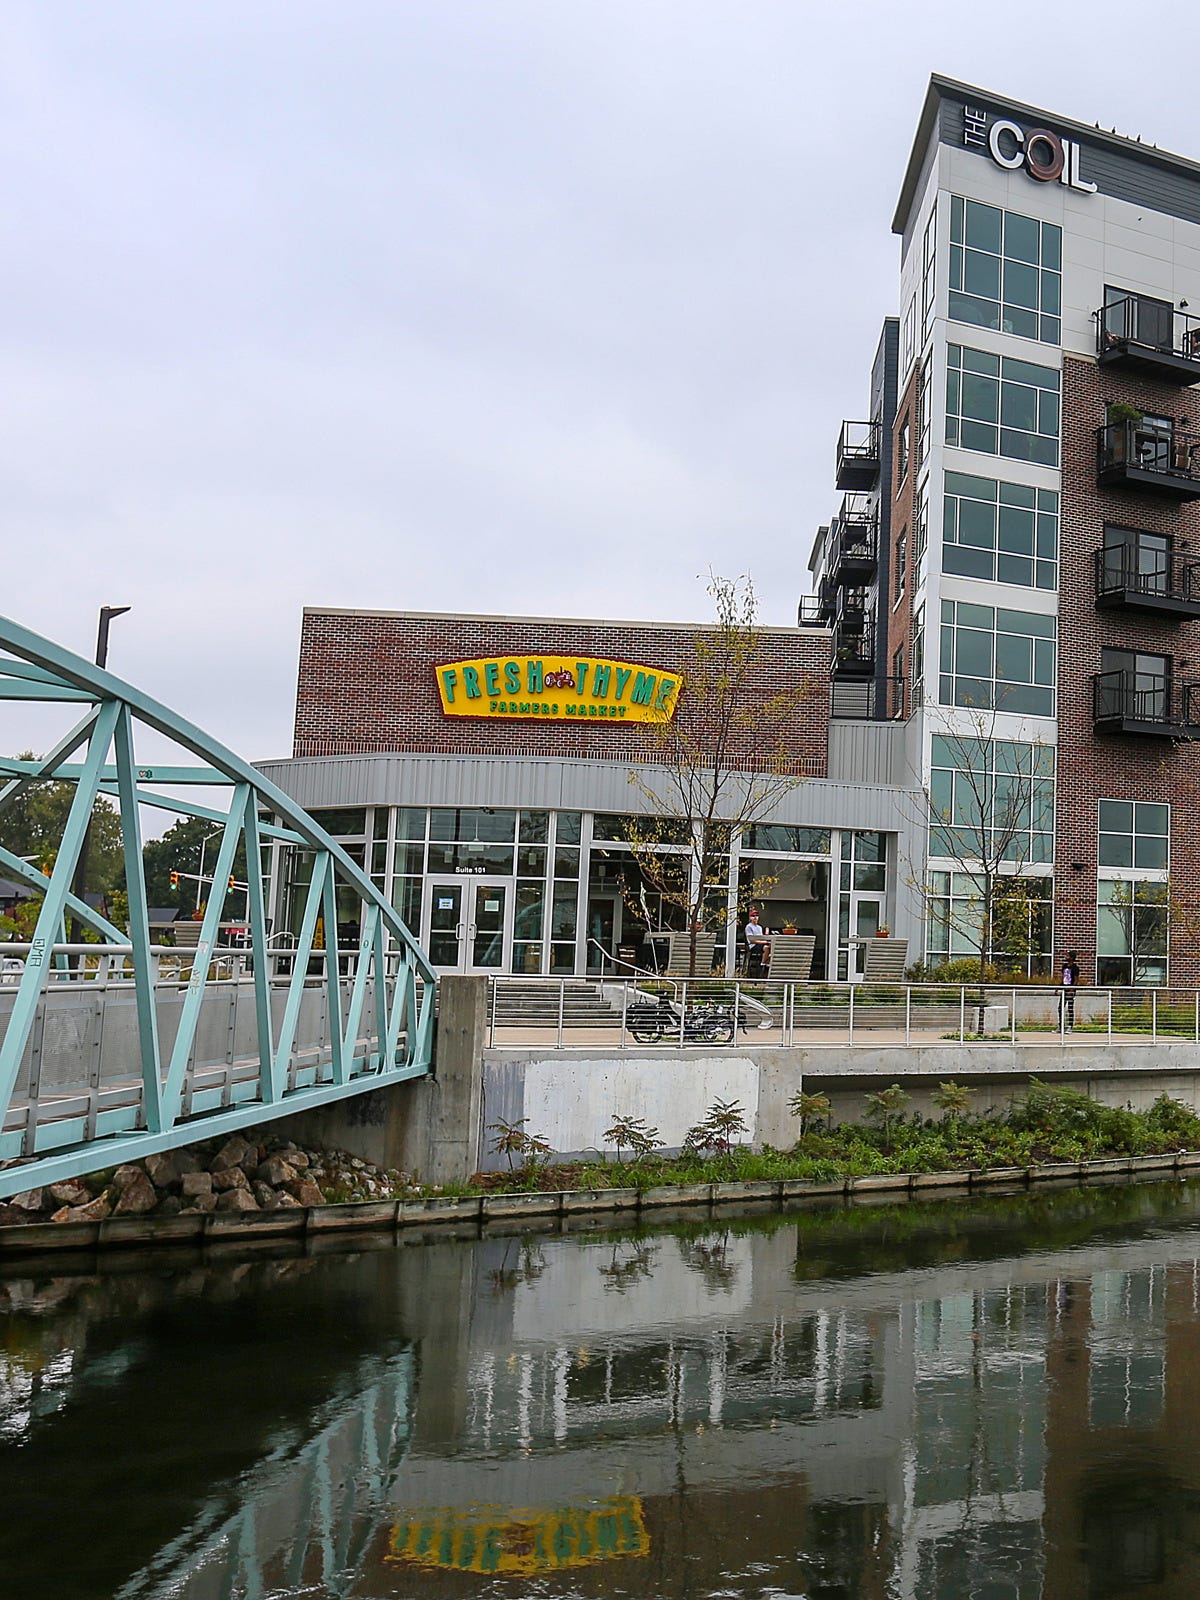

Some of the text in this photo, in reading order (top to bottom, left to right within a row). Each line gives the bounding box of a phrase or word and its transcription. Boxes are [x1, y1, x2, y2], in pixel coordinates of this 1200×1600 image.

[963, 104, 986, 146] THE
[989, 118, 1098, 194] COIL
[442, 660, 677, 711] FRESH THYME
[490, 701, 627, 717] FARMERS MARKET
[455, 866, 486, 874] Suite 101
